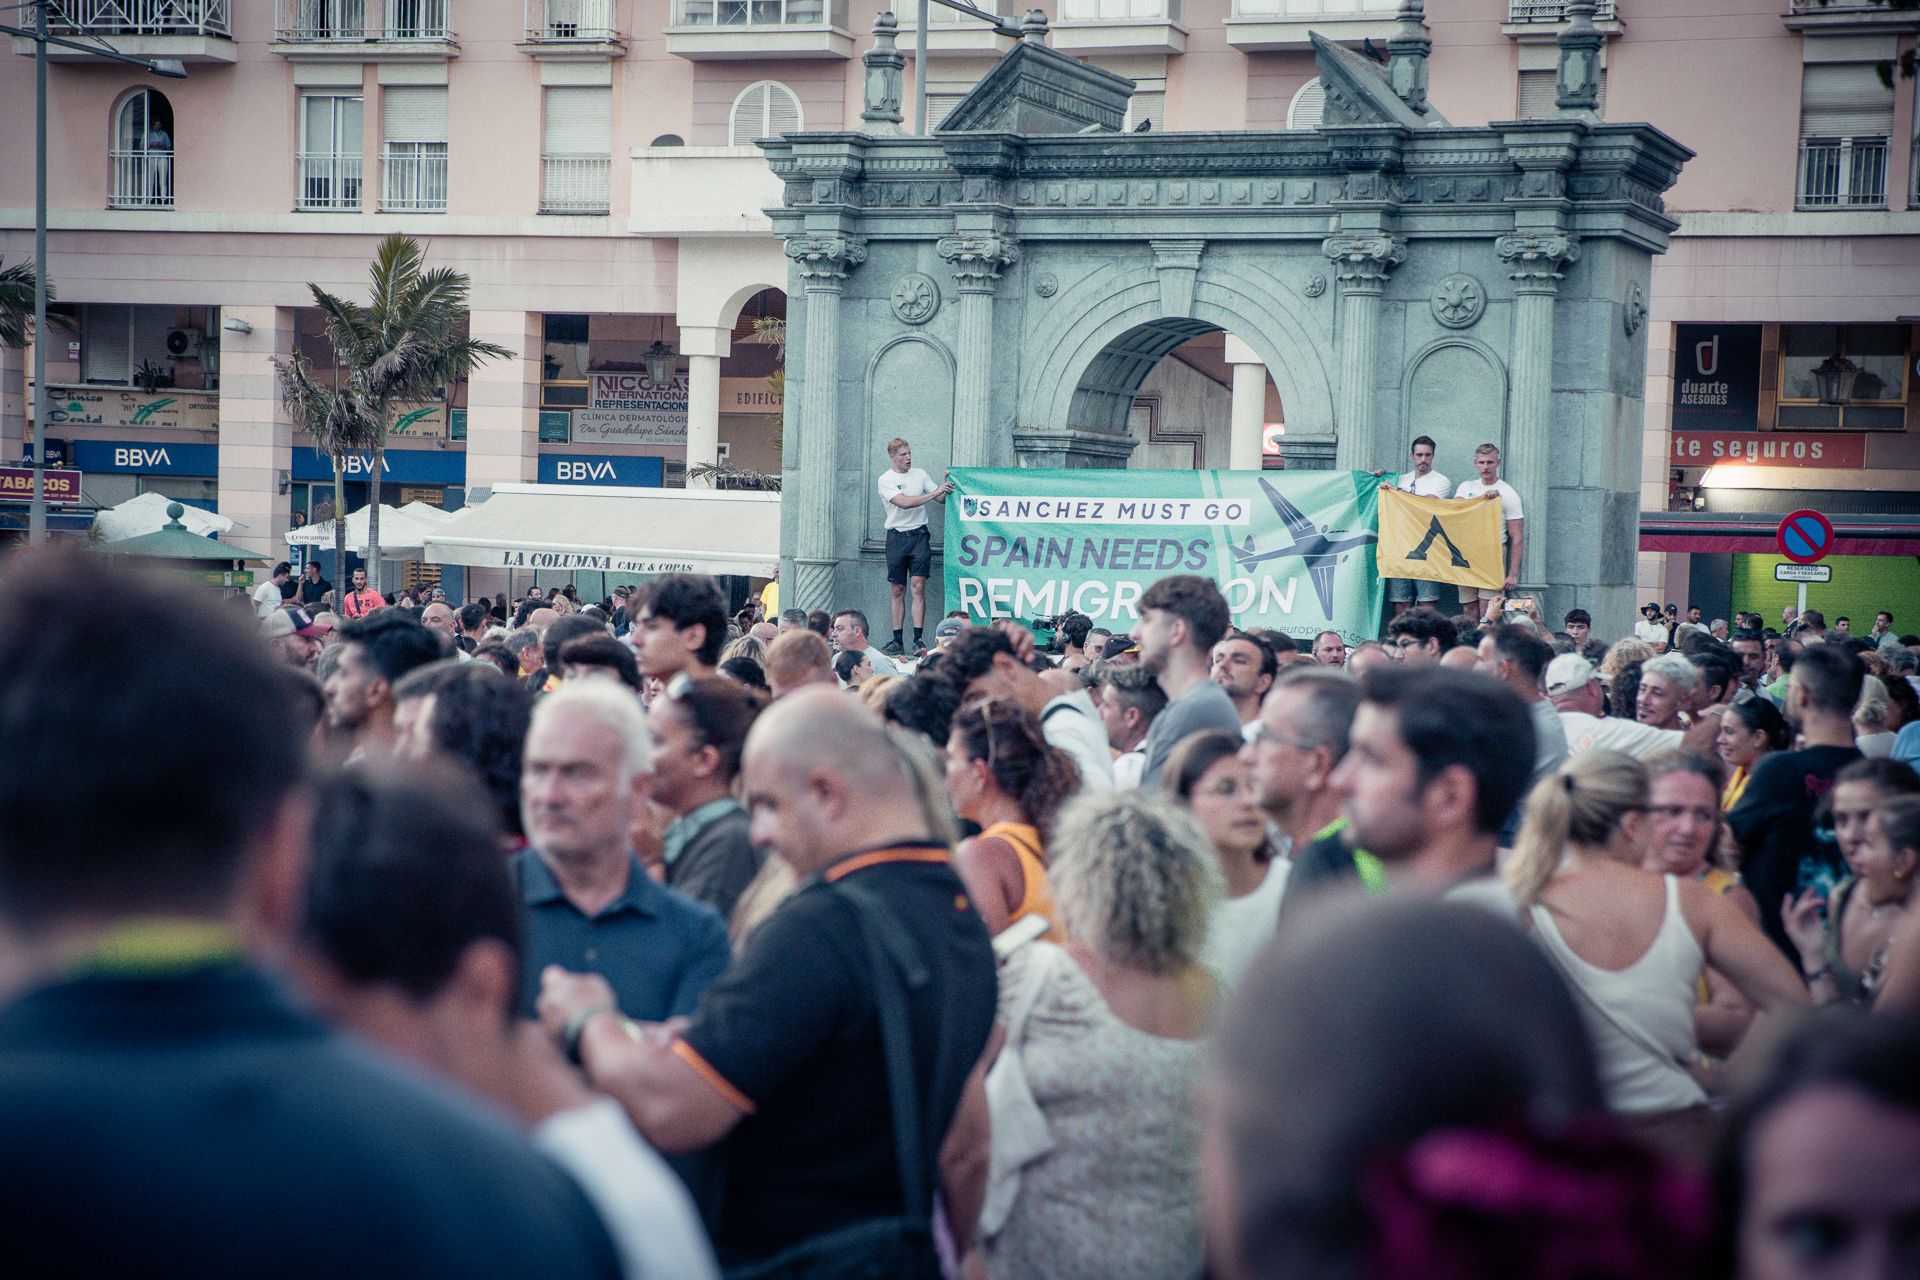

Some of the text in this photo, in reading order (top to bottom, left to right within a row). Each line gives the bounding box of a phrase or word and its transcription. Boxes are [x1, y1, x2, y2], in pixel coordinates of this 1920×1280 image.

[1681, 378, 1728, 394] duarte
[1680, 394, 1728, 406] ASESORES
[581, 412, 617, 422] CLÍNICA
[599, 423, 654, 439] Guadalupe
[115, 448, 171, 467] BBVA
[1713, 439, 1824, 463] seguros
[557, 461, 617, 481] BBVA
[979, 500, 1242, 520] SANCHEZ MUST GO
[503, 551, 694, 573] LA COLUMNA CAFE & COPAS
[958, 534, 1210, 571] SPAIN NEEDS
[958, 575, 1298, 621] REMIGRON
